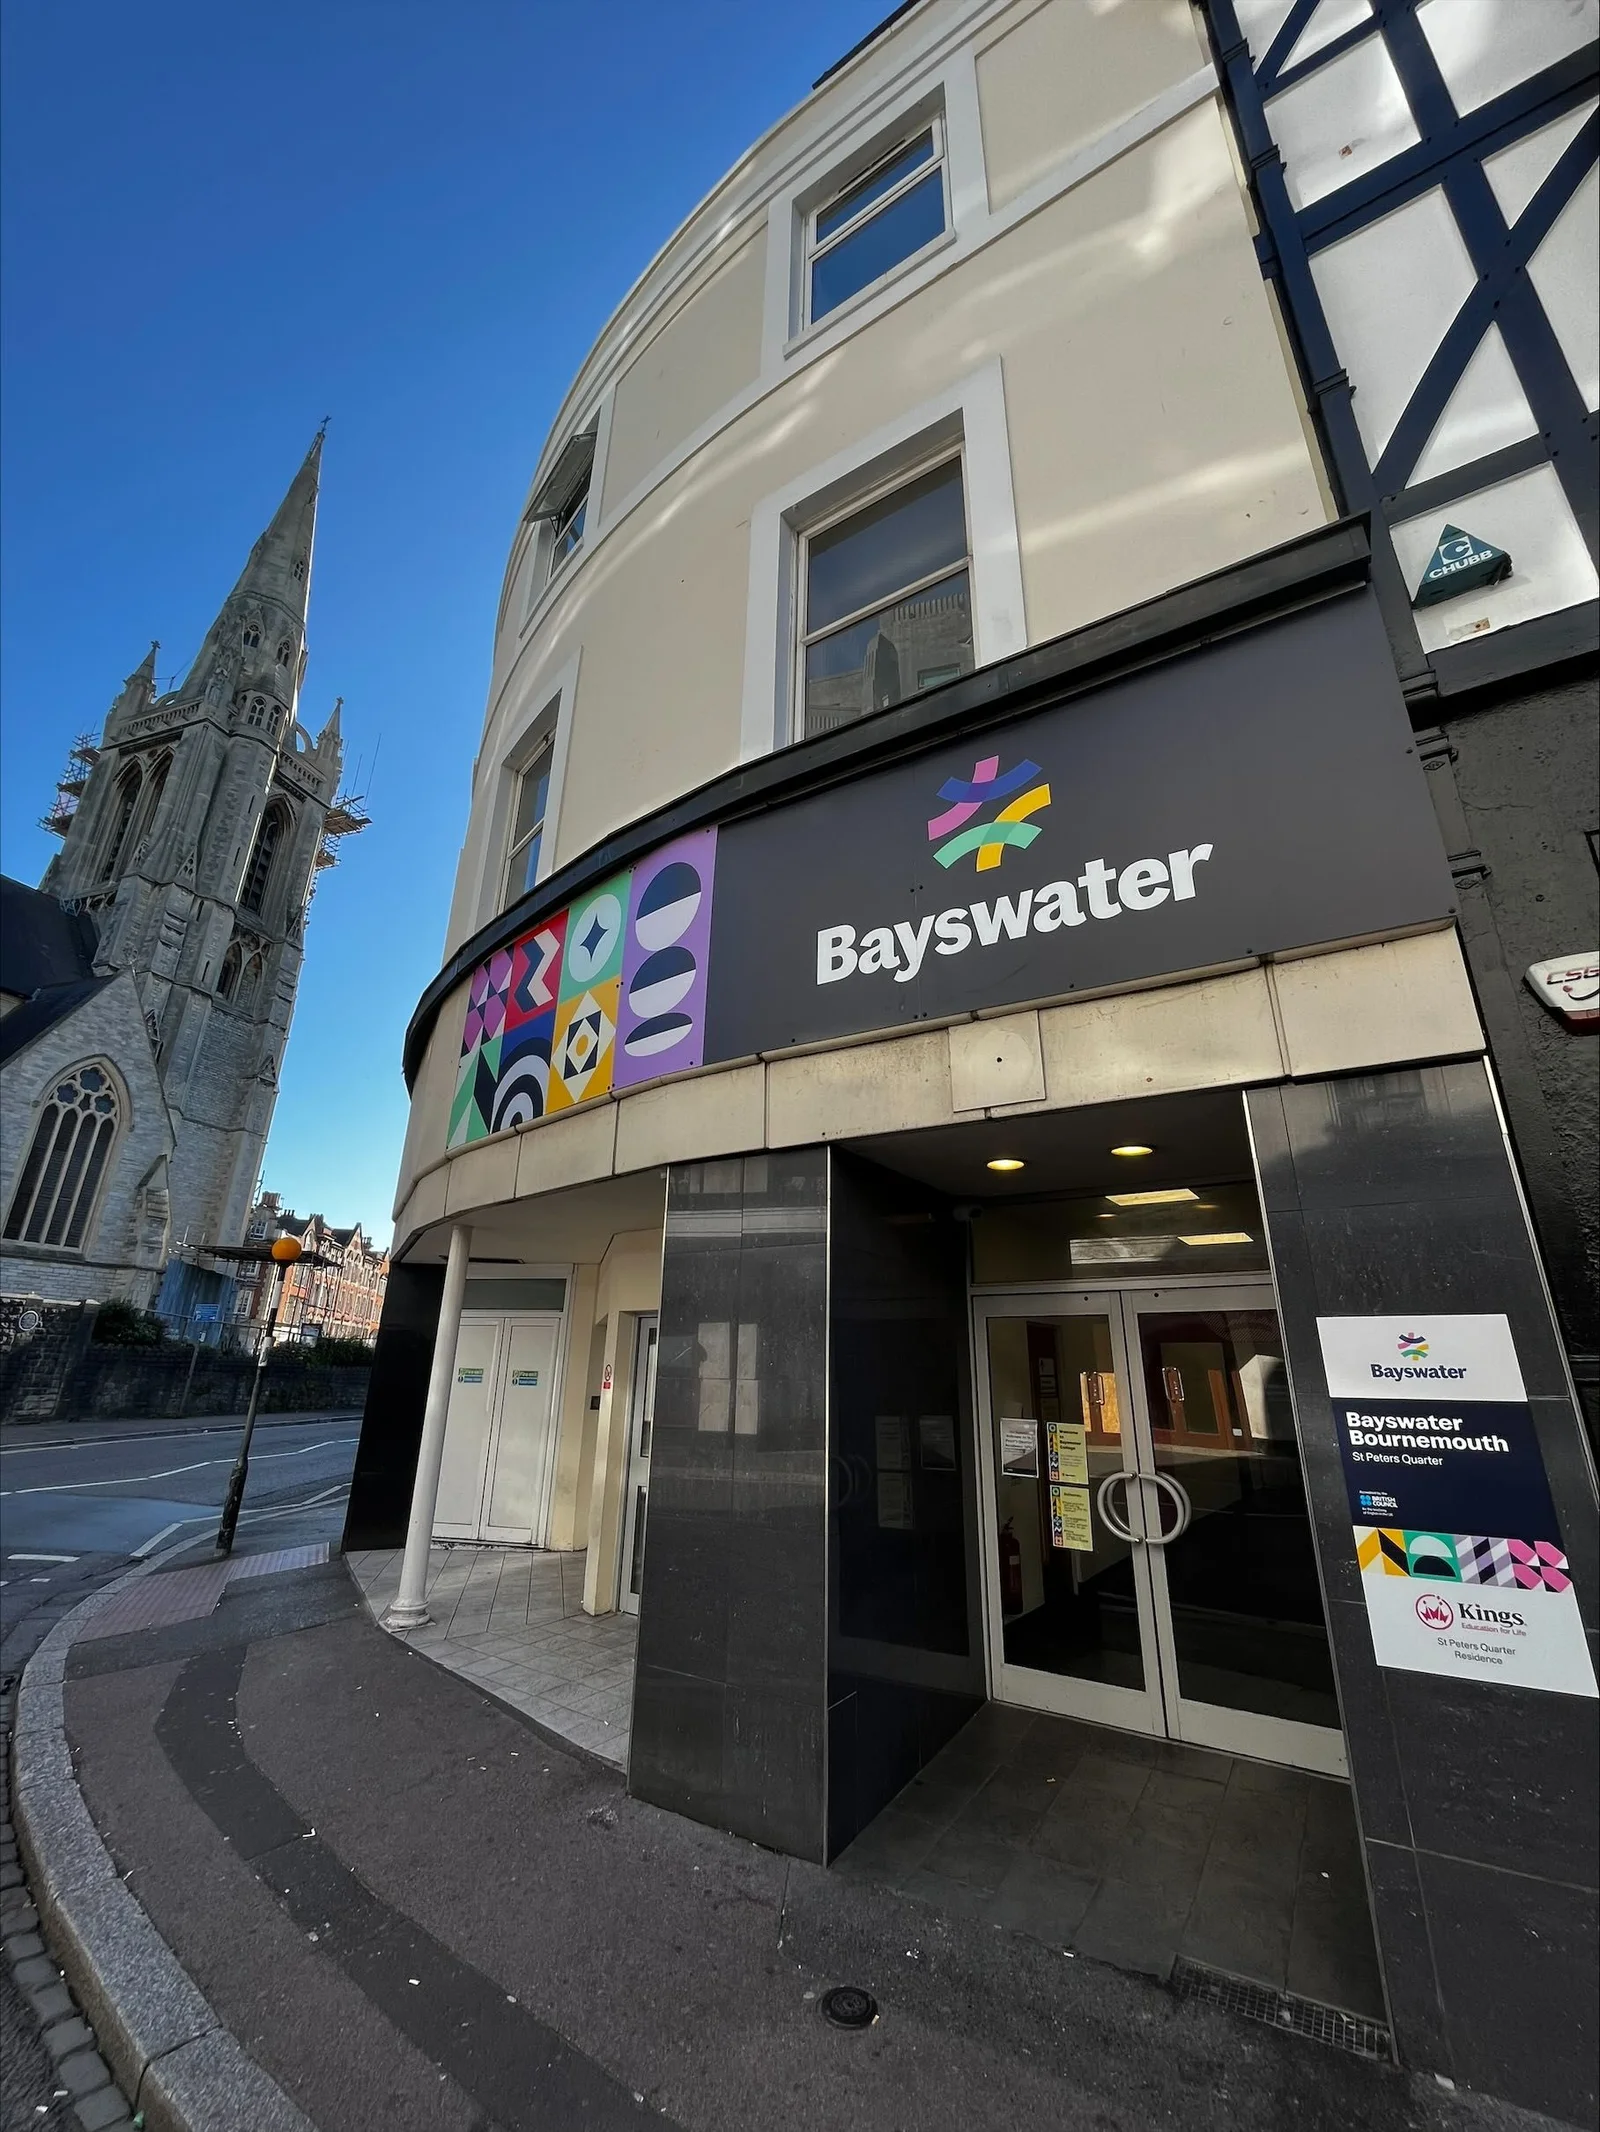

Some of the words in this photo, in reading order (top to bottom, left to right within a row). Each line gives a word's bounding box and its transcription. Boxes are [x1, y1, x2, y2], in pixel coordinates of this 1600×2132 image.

[1429, 549, 1494, 579] CHUBB
[816, 842, 1214, 986] Bayswater
[1370, 1363, 1467, 1382] Bayswater
[1345, 1411, 1464, 1432] Bayswater
[1349, 1429, 1510, 1453] Bournemouth
[1352, 1451, 1365, 1462] St
[1366, 1452, 1400, 1464] Peters
[1401, 1454, 1444, 1466] Quarter
[1372, 1501, 1399, 1509] COUNCIL
[1457, 1602, 1525, 1628] Kings
[1461, 1622, 1499, 1633] Education
[1500, 1627, 1510, 1635] for
[1512, 1629, 1527, 1637] Life
[1437, 1637, 1447, 1646] St
[1448, 1639, 1479, 1650] Peters
[1480, 1643, 1516, 1656] Quarter
[1454, 1650, 1503, 1665] Residence
